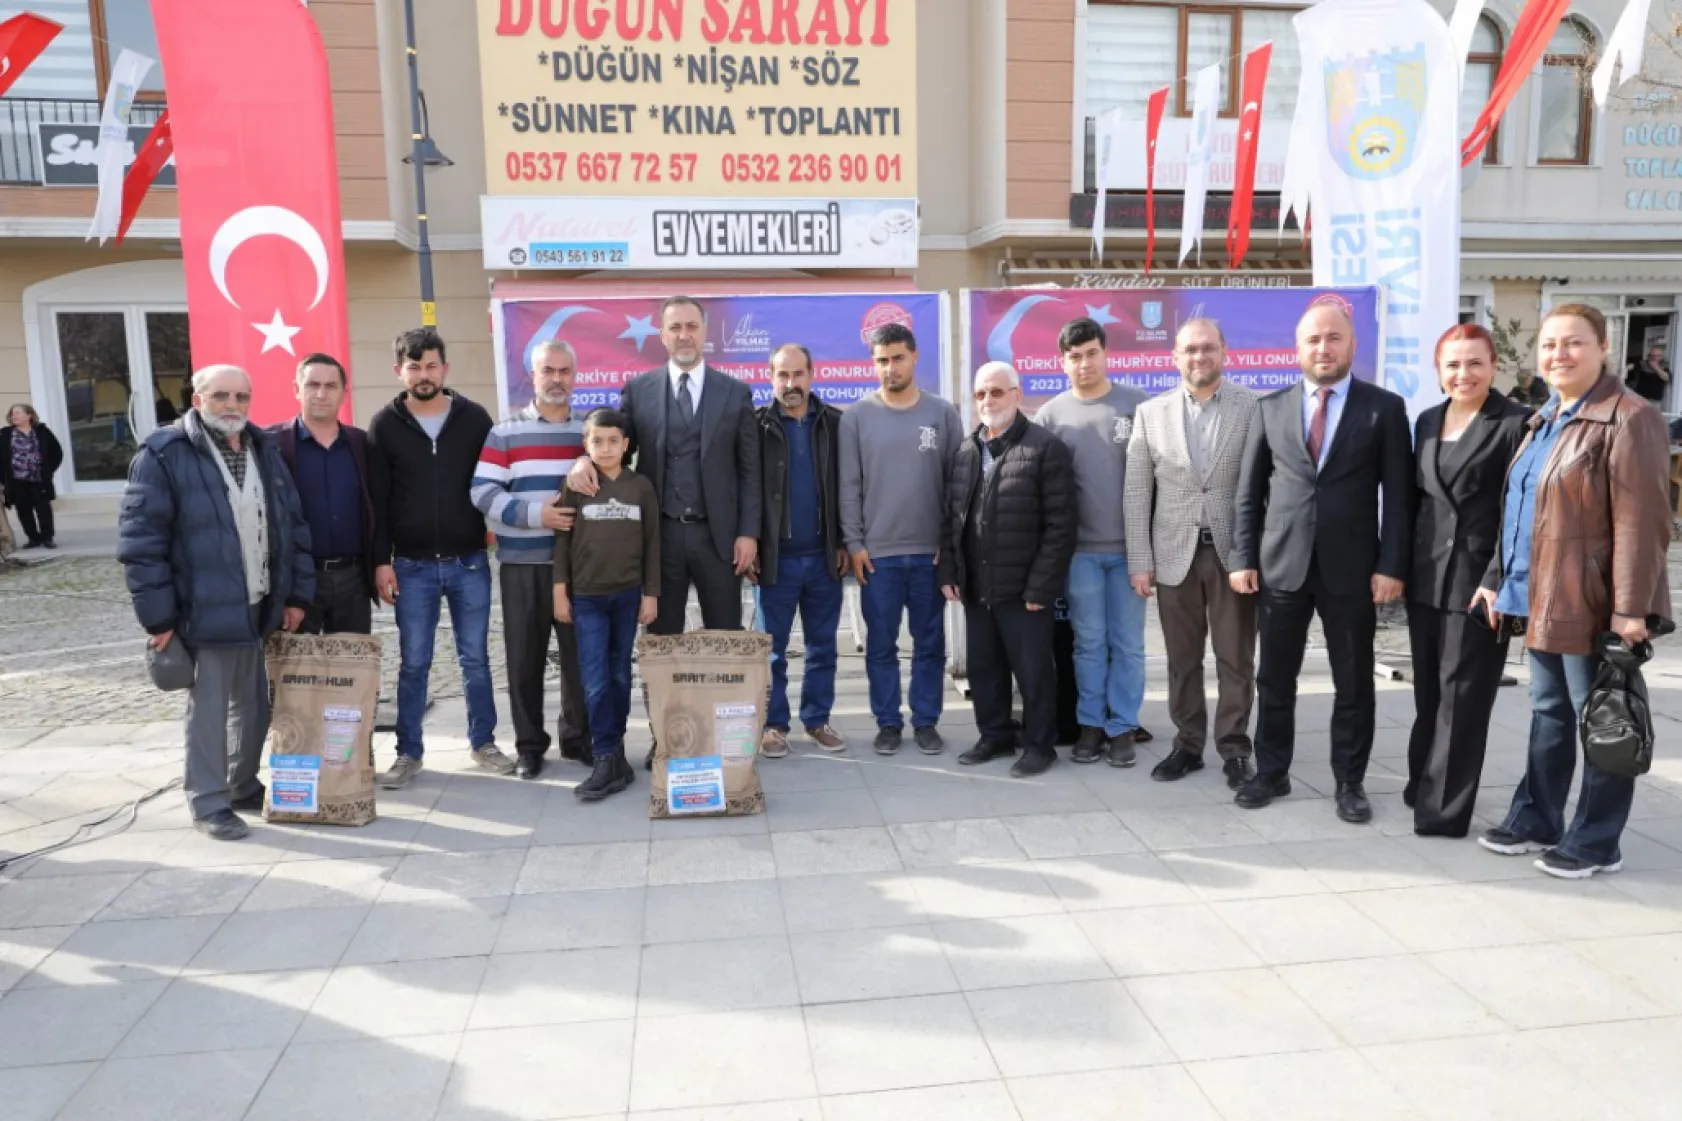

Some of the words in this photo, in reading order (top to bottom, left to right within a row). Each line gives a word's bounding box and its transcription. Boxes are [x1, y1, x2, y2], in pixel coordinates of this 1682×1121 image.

[700, 0, 890, 46] SARAYI
[506, 151, 568, 181] 0537
[576, 152, 622, 182] 667
[630, 153, 661, 182] 72
[669, 153, 698, 182] 57
[721, 153, 781, 182] 0532
[788, 154, 832, 182] 236
[839, 154, 869, 182] 90
[875, 154, 902, 182] 01
[1624, 157, 1682, 178] TOPLA
[1625, 189, 1682, 211] SALO
[653, 211, 690, 256] EV
[691, 202, 841, 256] YEMEKLERİ
[535, 250, 564, 263] 0543
[568, 251, 588, 263] 561
[592, 251, 606, 263] 91
[610, 250, 624, 263] 22
[1237, 354, 1262, 365] YILI
[574, 367, 619, 384] RKİYE
[1030, 379, 1062, 390] 2023
[572, 393, 606, 406] 2023
